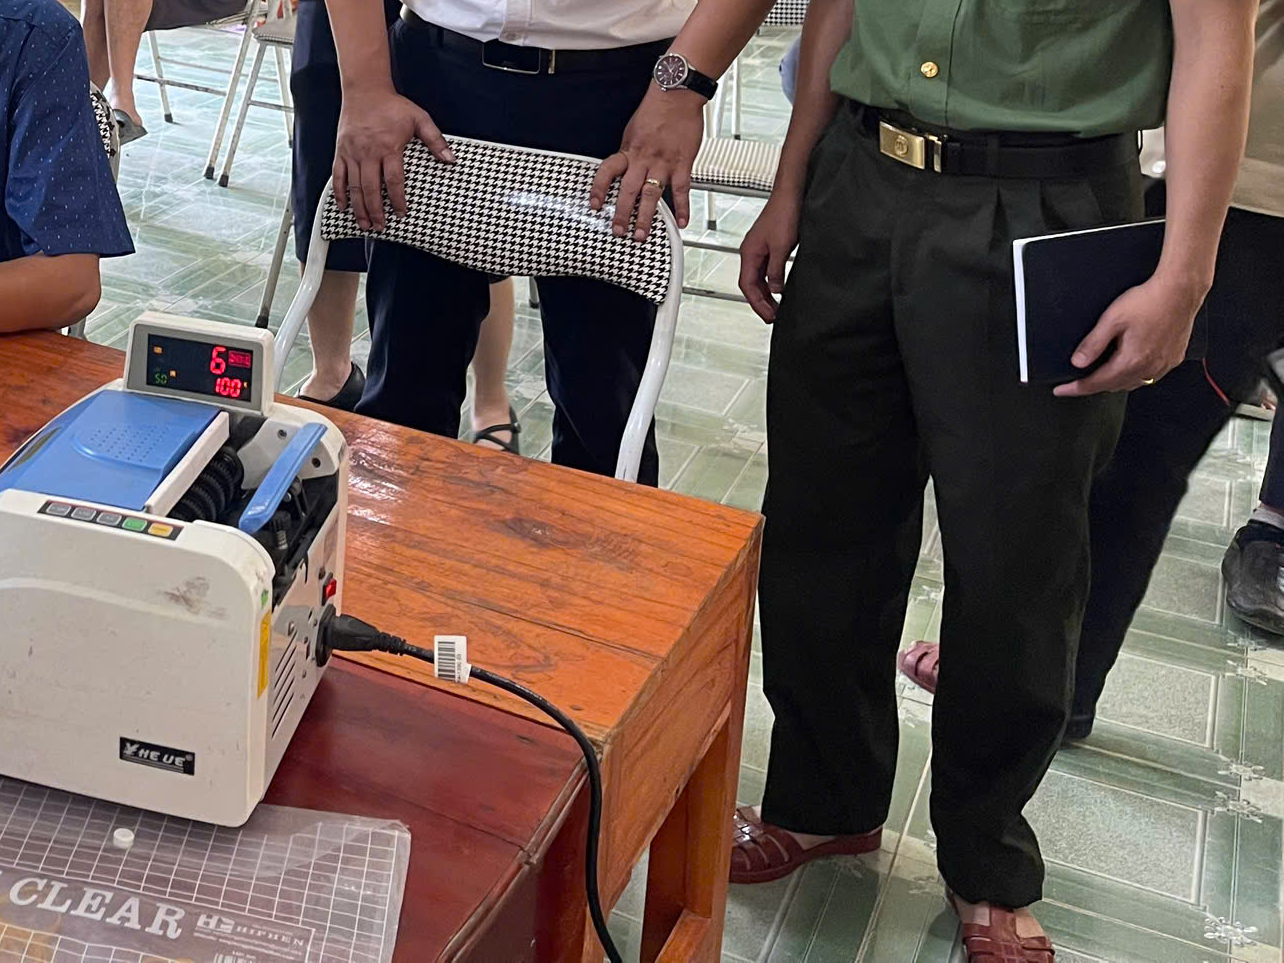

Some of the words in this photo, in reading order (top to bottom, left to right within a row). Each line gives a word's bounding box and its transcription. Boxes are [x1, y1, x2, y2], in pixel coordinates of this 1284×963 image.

[210, 346, 227, 375] 6
[215, 377, 242, 398] 100
[9, 877, 186, 939] CLEAR
